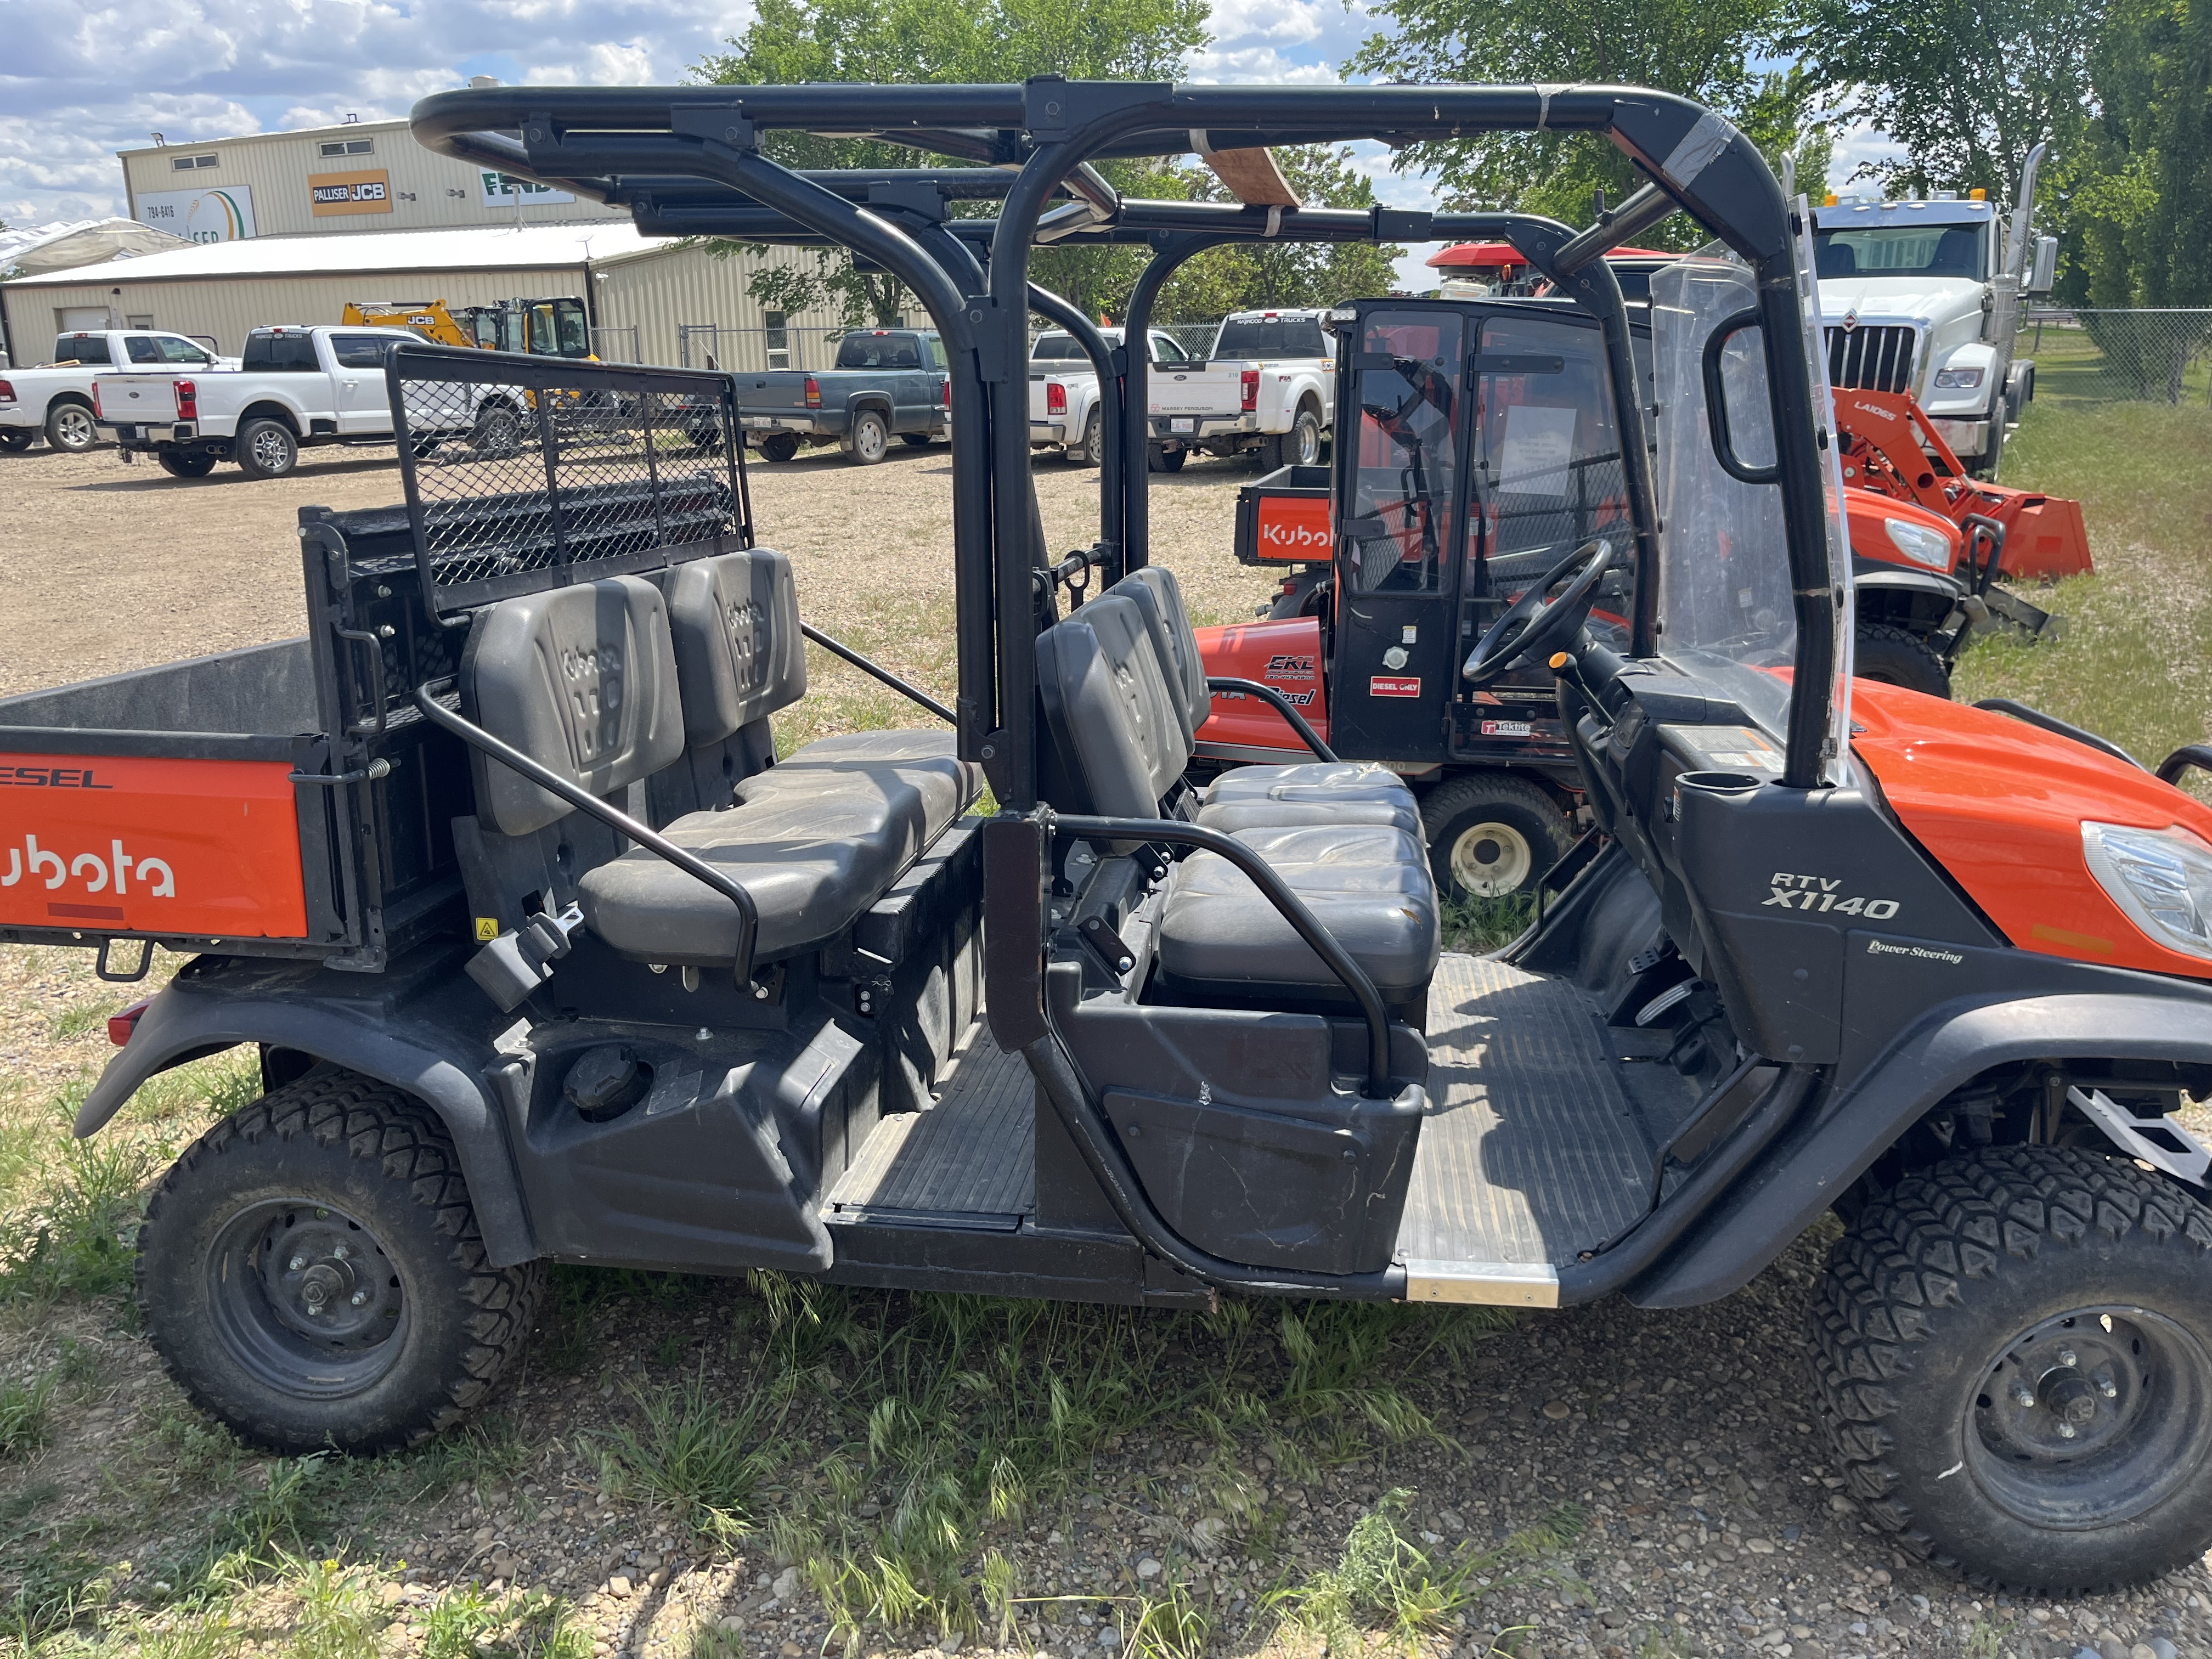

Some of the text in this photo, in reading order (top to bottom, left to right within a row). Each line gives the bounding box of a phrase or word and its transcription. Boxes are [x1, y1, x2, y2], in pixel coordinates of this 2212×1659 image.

[314, 183, 386, 201] PALLISER JCB
[147, 205, 174, 219] 794-6416
[407, 315, 435, 325] JCB
[1322, 360, 1335, 370] JCB
[1266, 655, 1314, 670] EKL
[1498, 723, 1531, 731] Tektite
[1771, 872, 1842, 891] RTV
[1762, 887, 1900, 920] X1140
[1869, 940, 1963, 964] Power Steering
